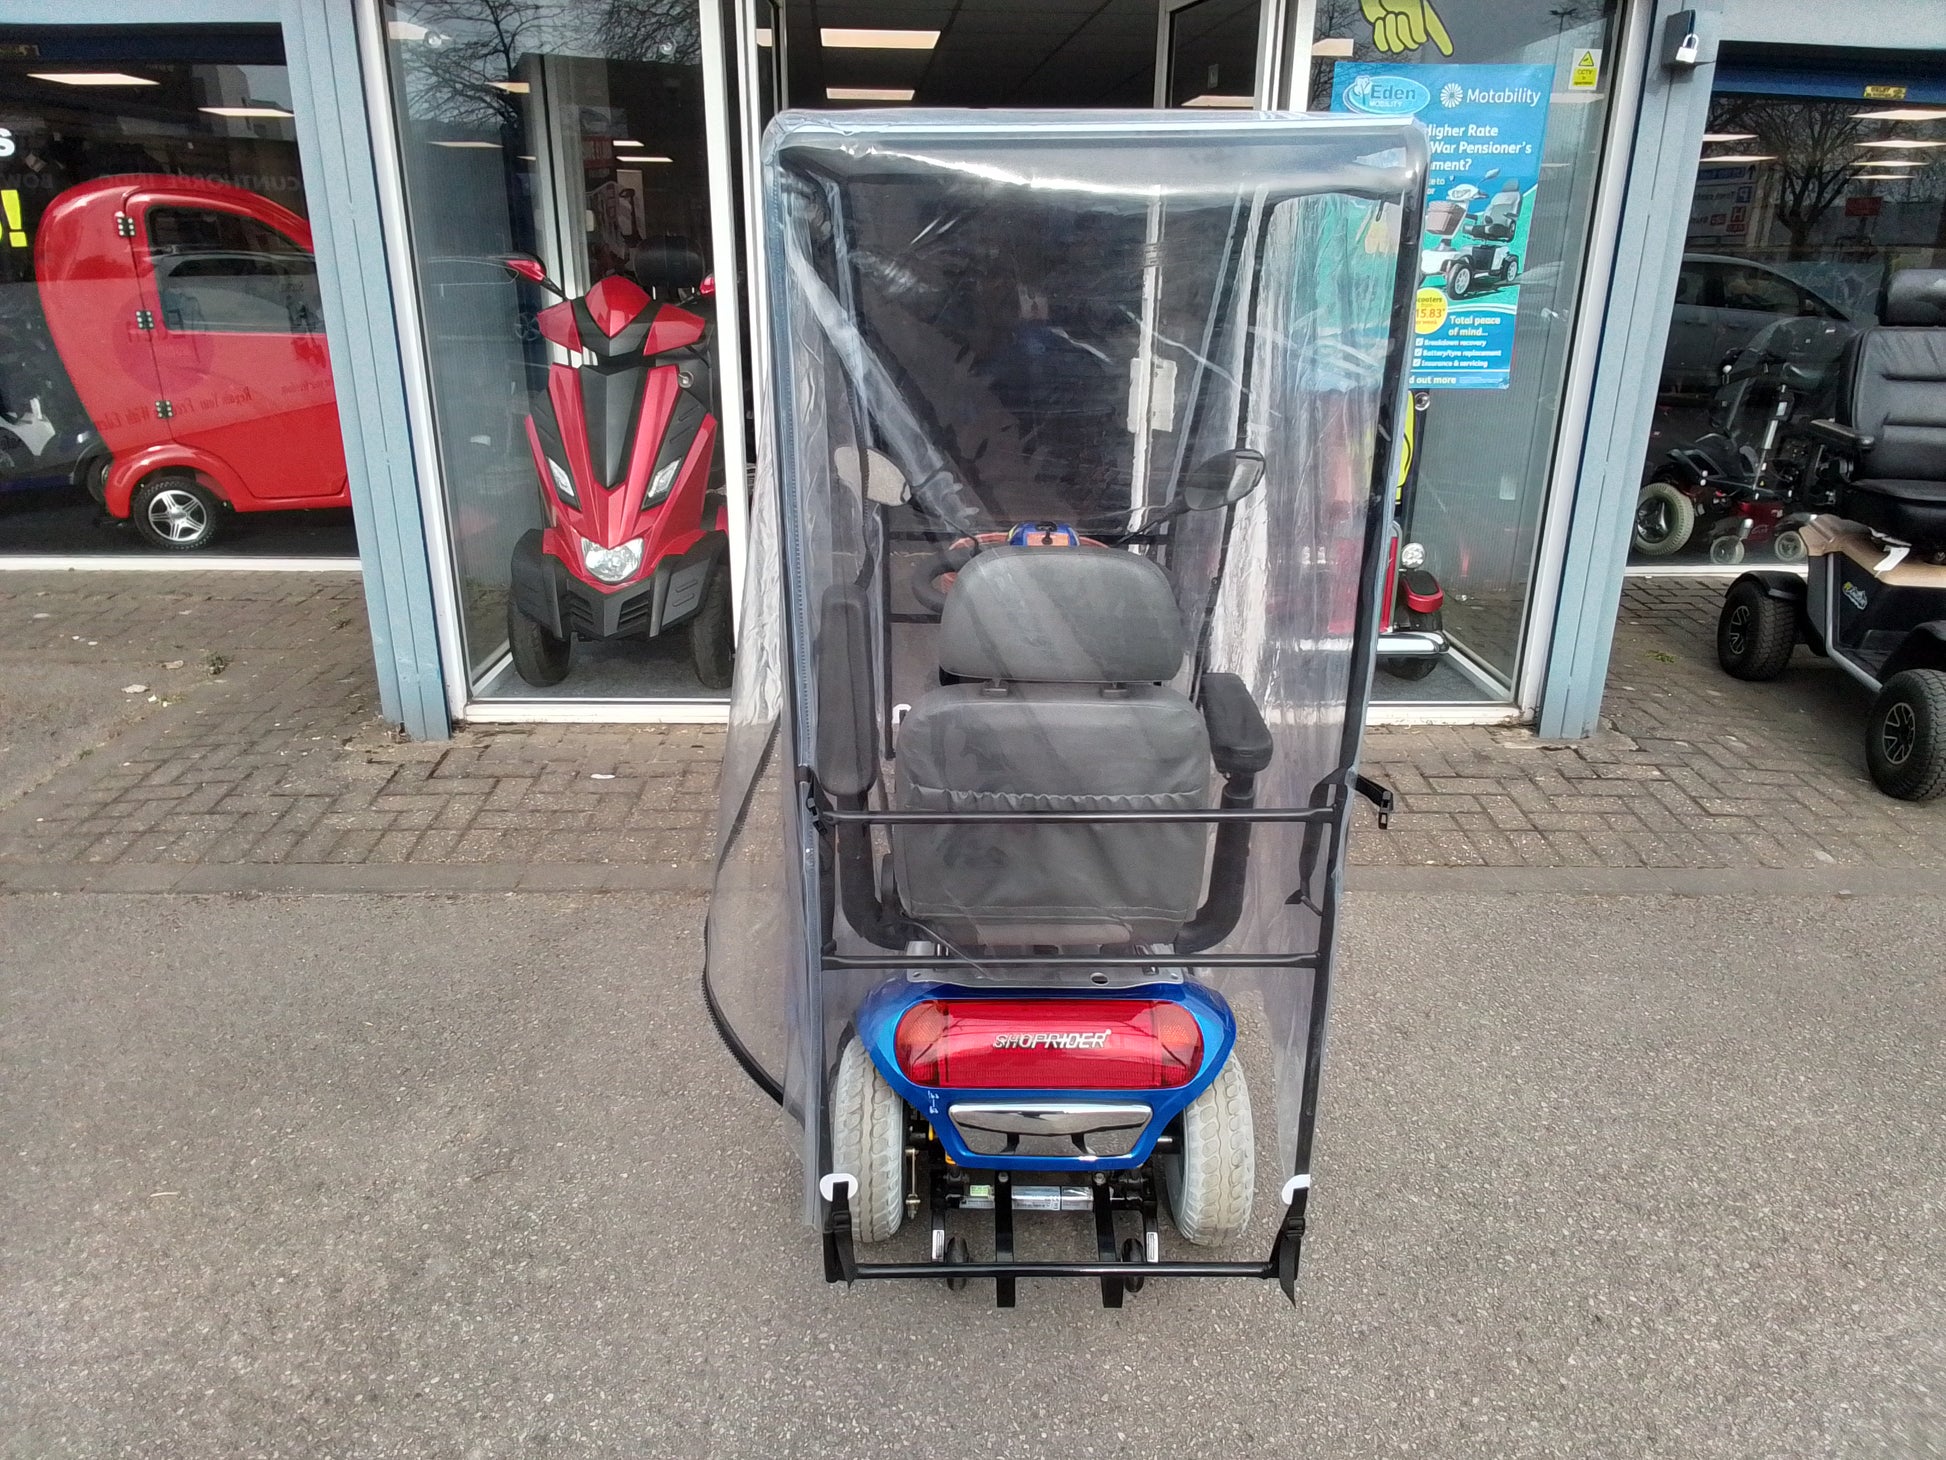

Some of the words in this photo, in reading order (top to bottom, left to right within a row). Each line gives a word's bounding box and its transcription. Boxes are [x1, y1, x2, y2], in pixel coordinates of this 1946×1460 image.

[1370, 84, 1416, 100] Eden
[1466, 89, 1541, 107] Motability
[1368, 100, 1403, 108] MOBILITY
[1467, 124, 1499, 137] Rate
[1430, 141, 1457, 154] War
[1459, 141, 1532, 154] Pensioner's
[1430, 158, 1472, 171] ment?
[1436, 177, 1446, 186] to
[1449, 315, 1473, 325] Total
[1474, 317, 1501, 326] peace
[1448, 327, 1459, 336] of
[1459, 340, 1487, 348] recovery
[1462, 349, 1502, 358] replacement
[1459, 360, 1489, 368] servicing
[1416, 375, 1432, 384] out
[1433, 376, 1457, 384] more
[993, 1030, 1108, 1049] SHOPRIDER
